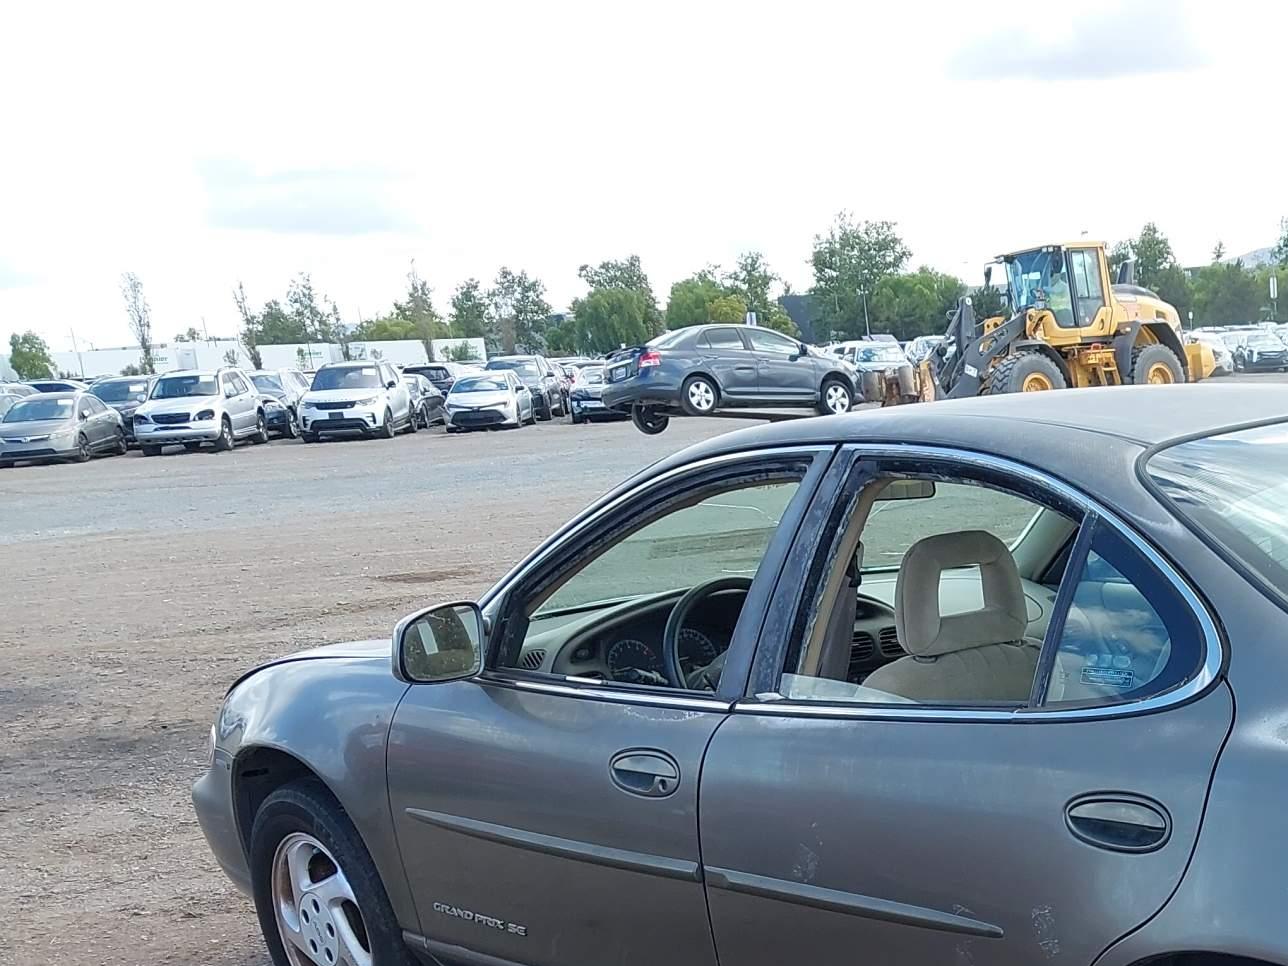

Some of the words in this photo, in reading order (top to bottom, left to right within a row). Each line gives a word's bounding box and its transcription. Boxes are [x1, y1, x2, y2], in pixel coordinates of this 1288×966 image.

[433, 902, 474, 920] GRAND
[474, 913, 505, 930] PRIX
[507, 922, 527, 936] SE
